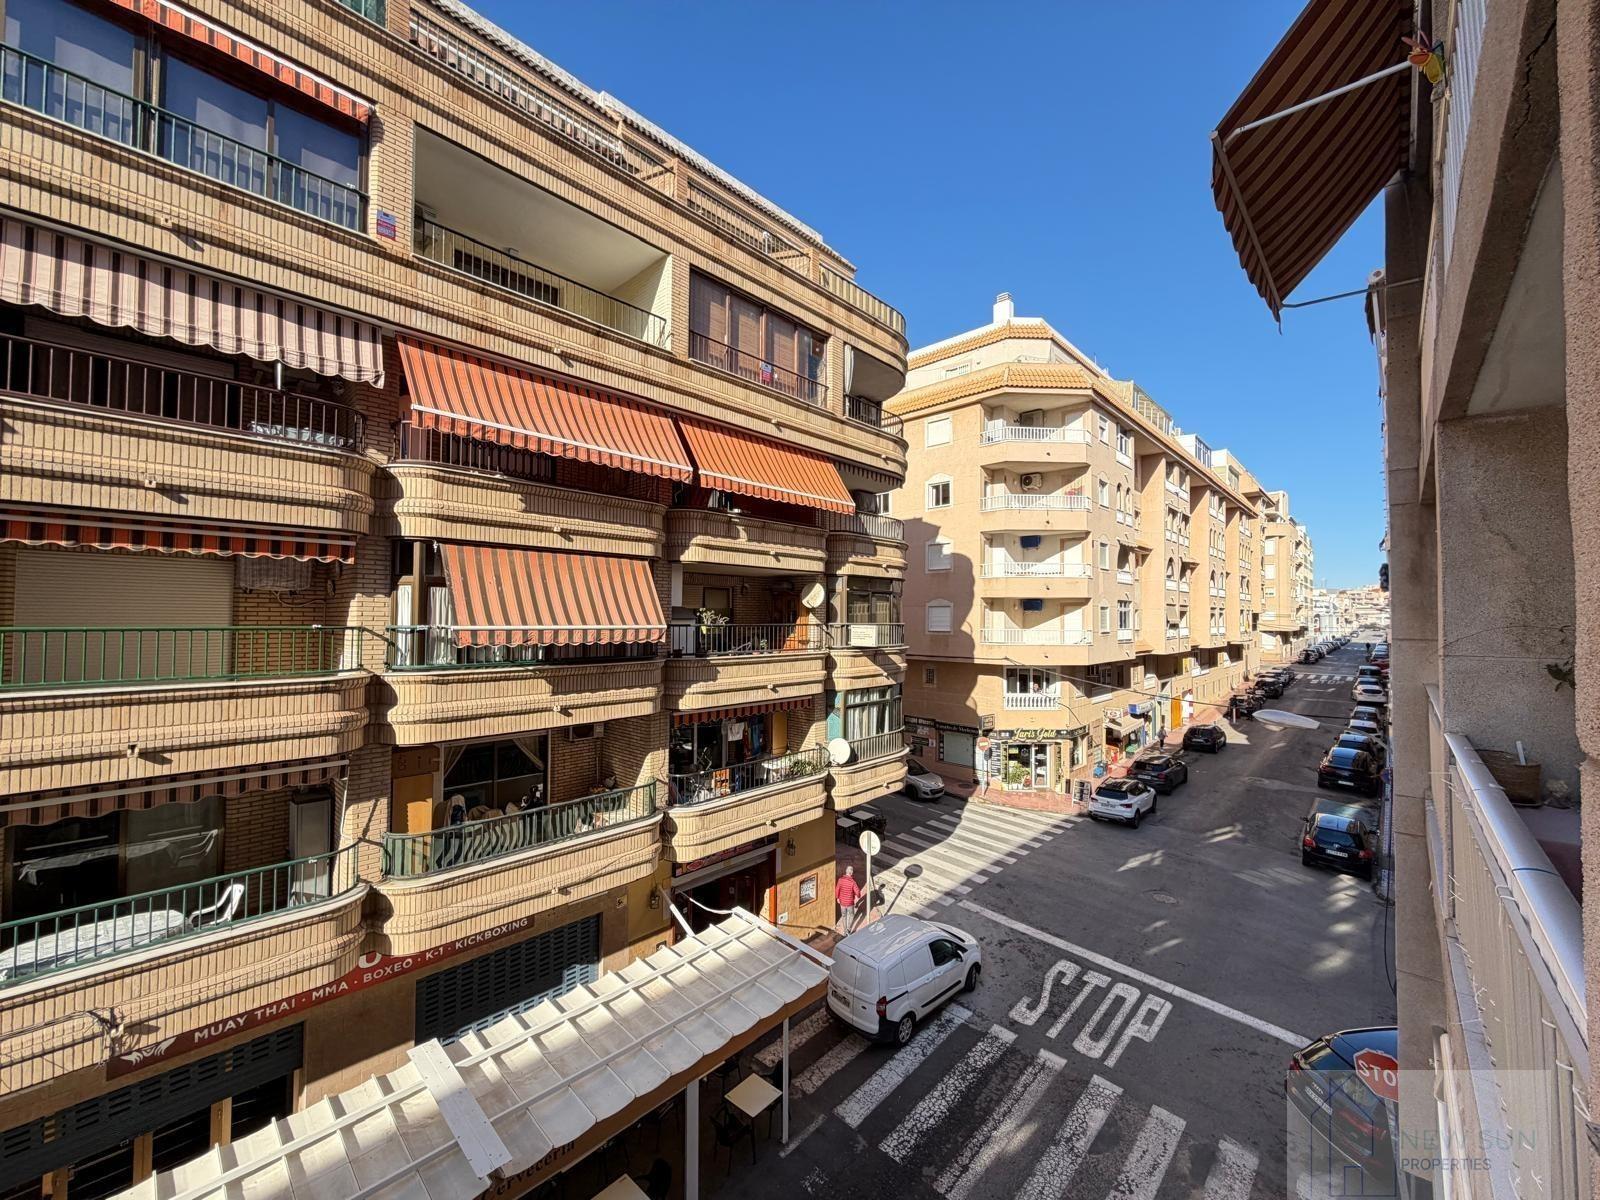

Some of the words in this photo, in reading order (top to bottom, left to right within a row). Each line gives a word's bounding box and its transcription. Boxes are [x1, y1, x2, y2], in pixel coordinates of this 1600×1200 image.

[1036, 727, 1057, 741] Gold
[194, 1014, 248, 1043] MUAY
[254, 999, 296, 1020] THAI
[311, 981, 349, 1001] MMA
[363, 958, 413, 983] BOXEO
[425, 946, 445, 961] K-1
[455, 917, 528, 950] KICKBOXING
[1008, 959, 1173, 1069] STOP
[1358, 1059, 1398, 1087] STO
